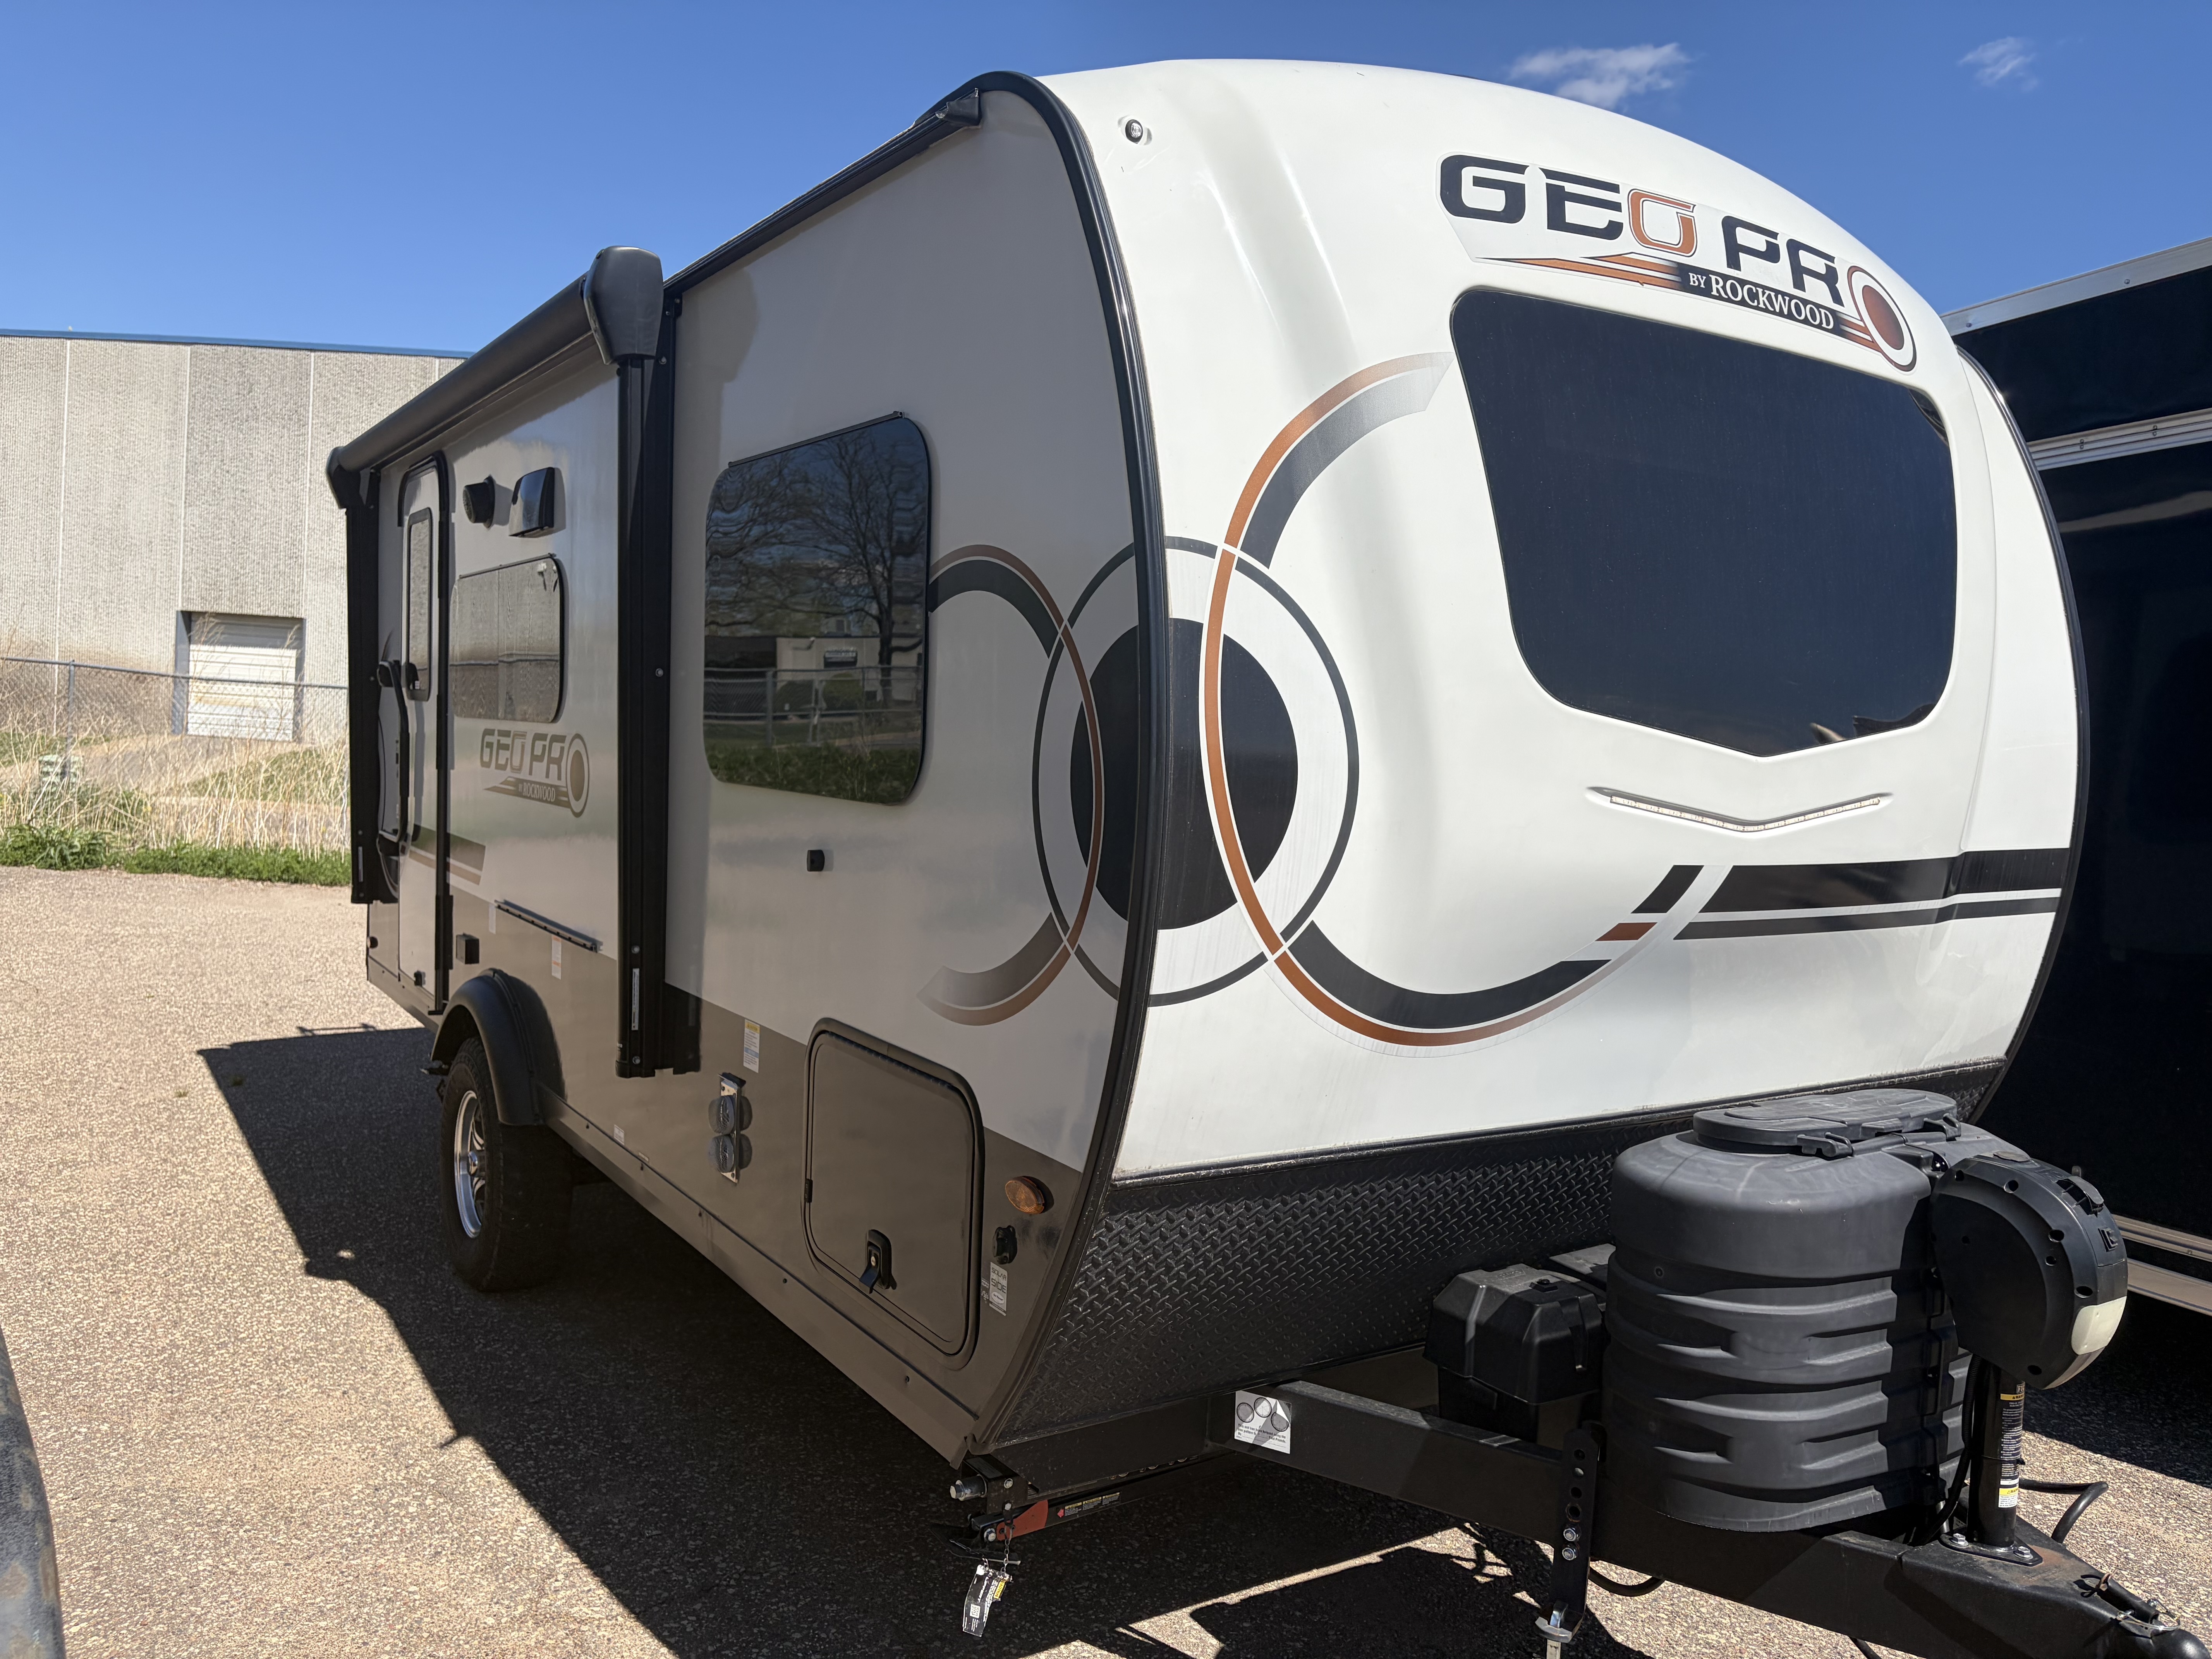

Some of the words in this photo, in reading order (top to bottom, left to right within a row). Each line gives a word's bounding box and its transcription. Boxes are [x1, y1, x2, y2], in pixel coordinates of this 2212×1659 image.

[1440, 154, 1697, 257] GEO
[1688, 272, 1706, 289] BY
[1710, 275, 1834, 330] ROCKWOOD
[480, 728, 527, 774] GEO
[523, 782, 555, 802] ROCKWOOD
[991, 1267, 1006, 1281] SOLAR
[991, 1278, 1006, 1293] SIDE
